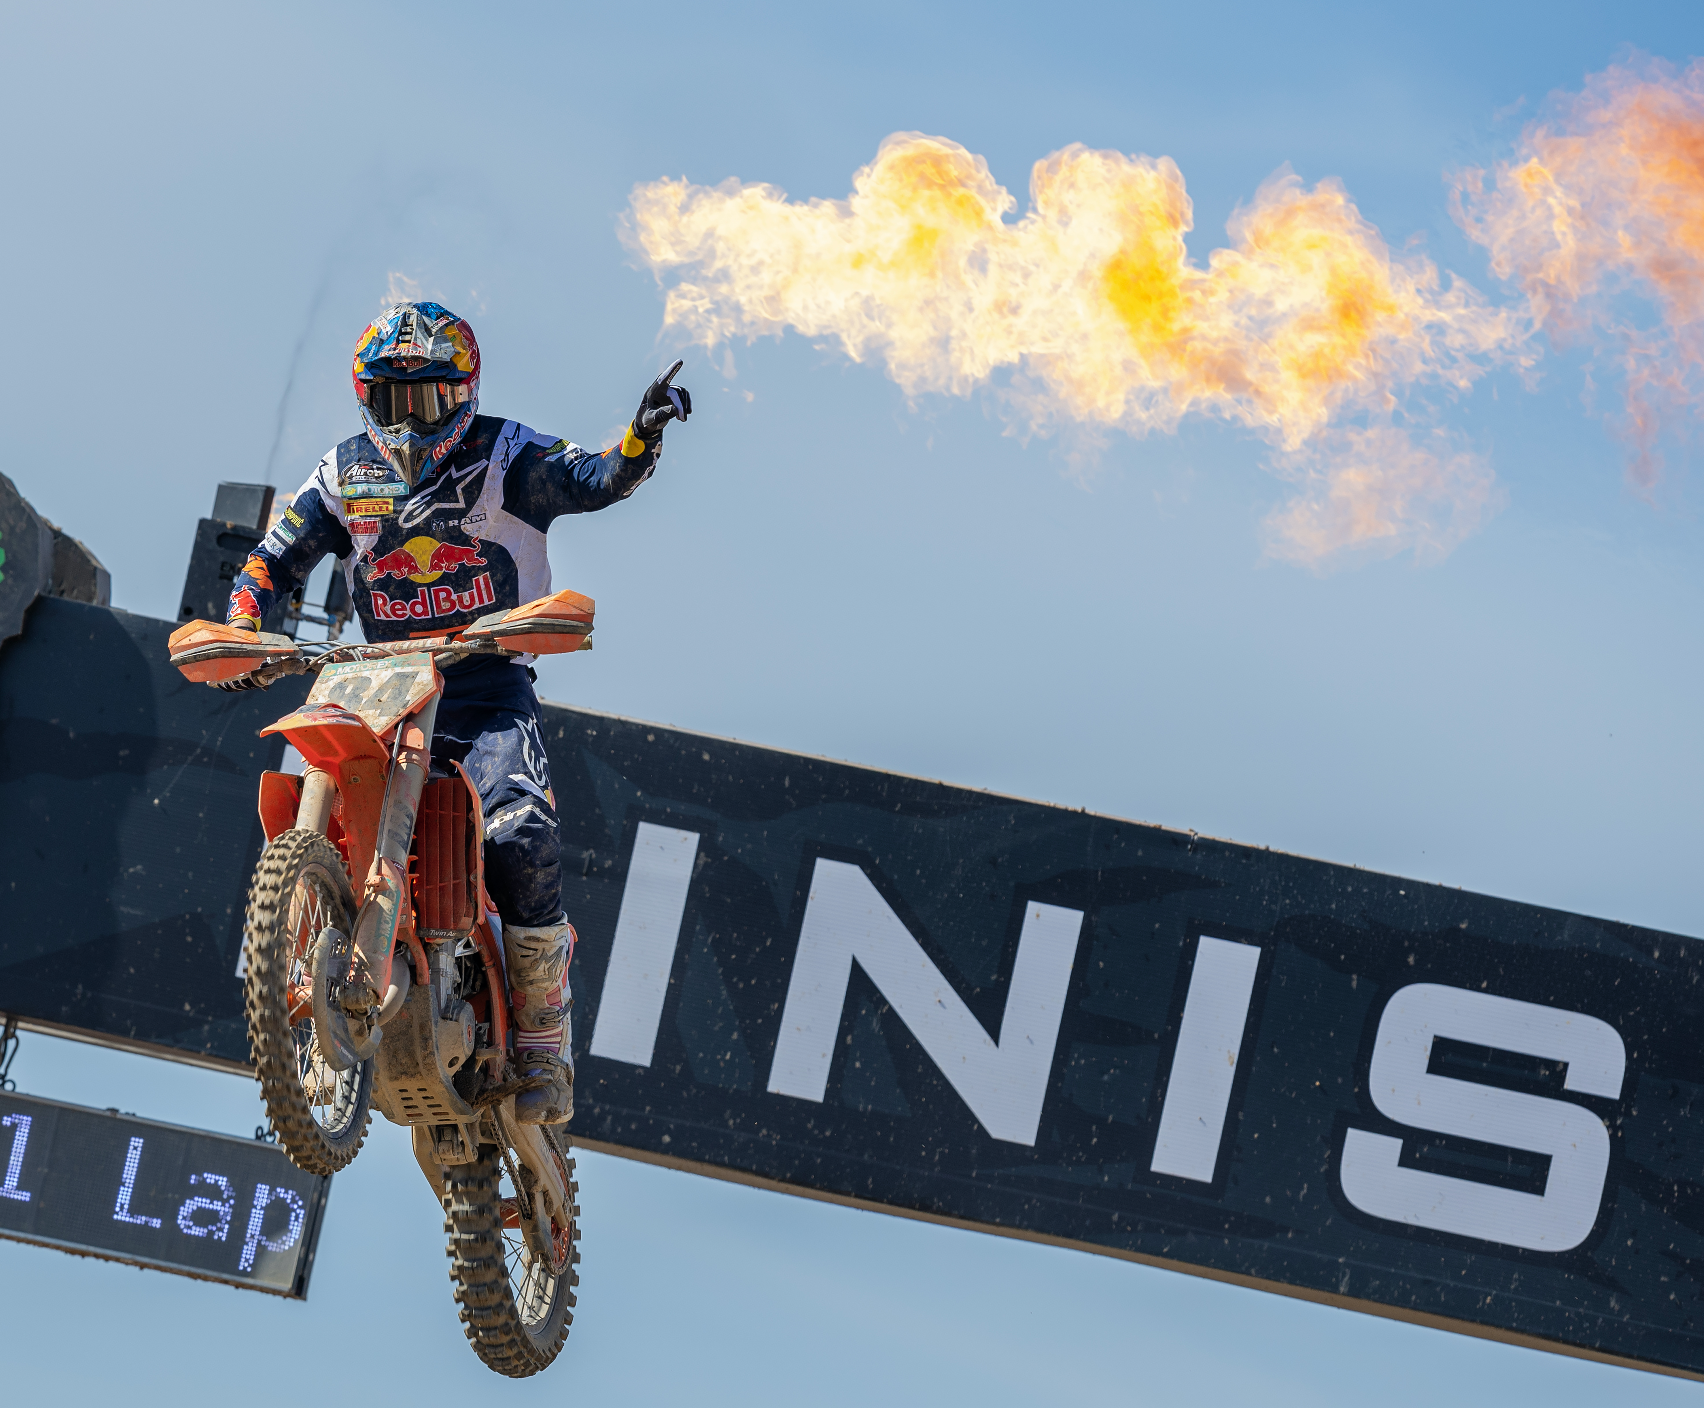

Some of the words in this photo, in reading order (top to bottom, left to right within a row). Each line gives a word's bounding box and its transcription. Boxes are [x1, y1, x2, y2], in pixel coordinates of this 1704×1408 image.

[357, 484, 406, 495] MOTOREX
[346, 500, 389, 514] PIRELLI
[448, 513, 487, 527] RAM
[371, 587, 432, 620] Red
[431, 572, 496, 617] Bull
[337, 660, 392, 675] MOTOREX
[328, 671, 420, 717] 84
[430, 929, 447, 937] Twin
[235, 744, 1626, 1252] INIS
[0, 1113, 32, 1202] 1
[113, 1136, 305, 1272] Lap
